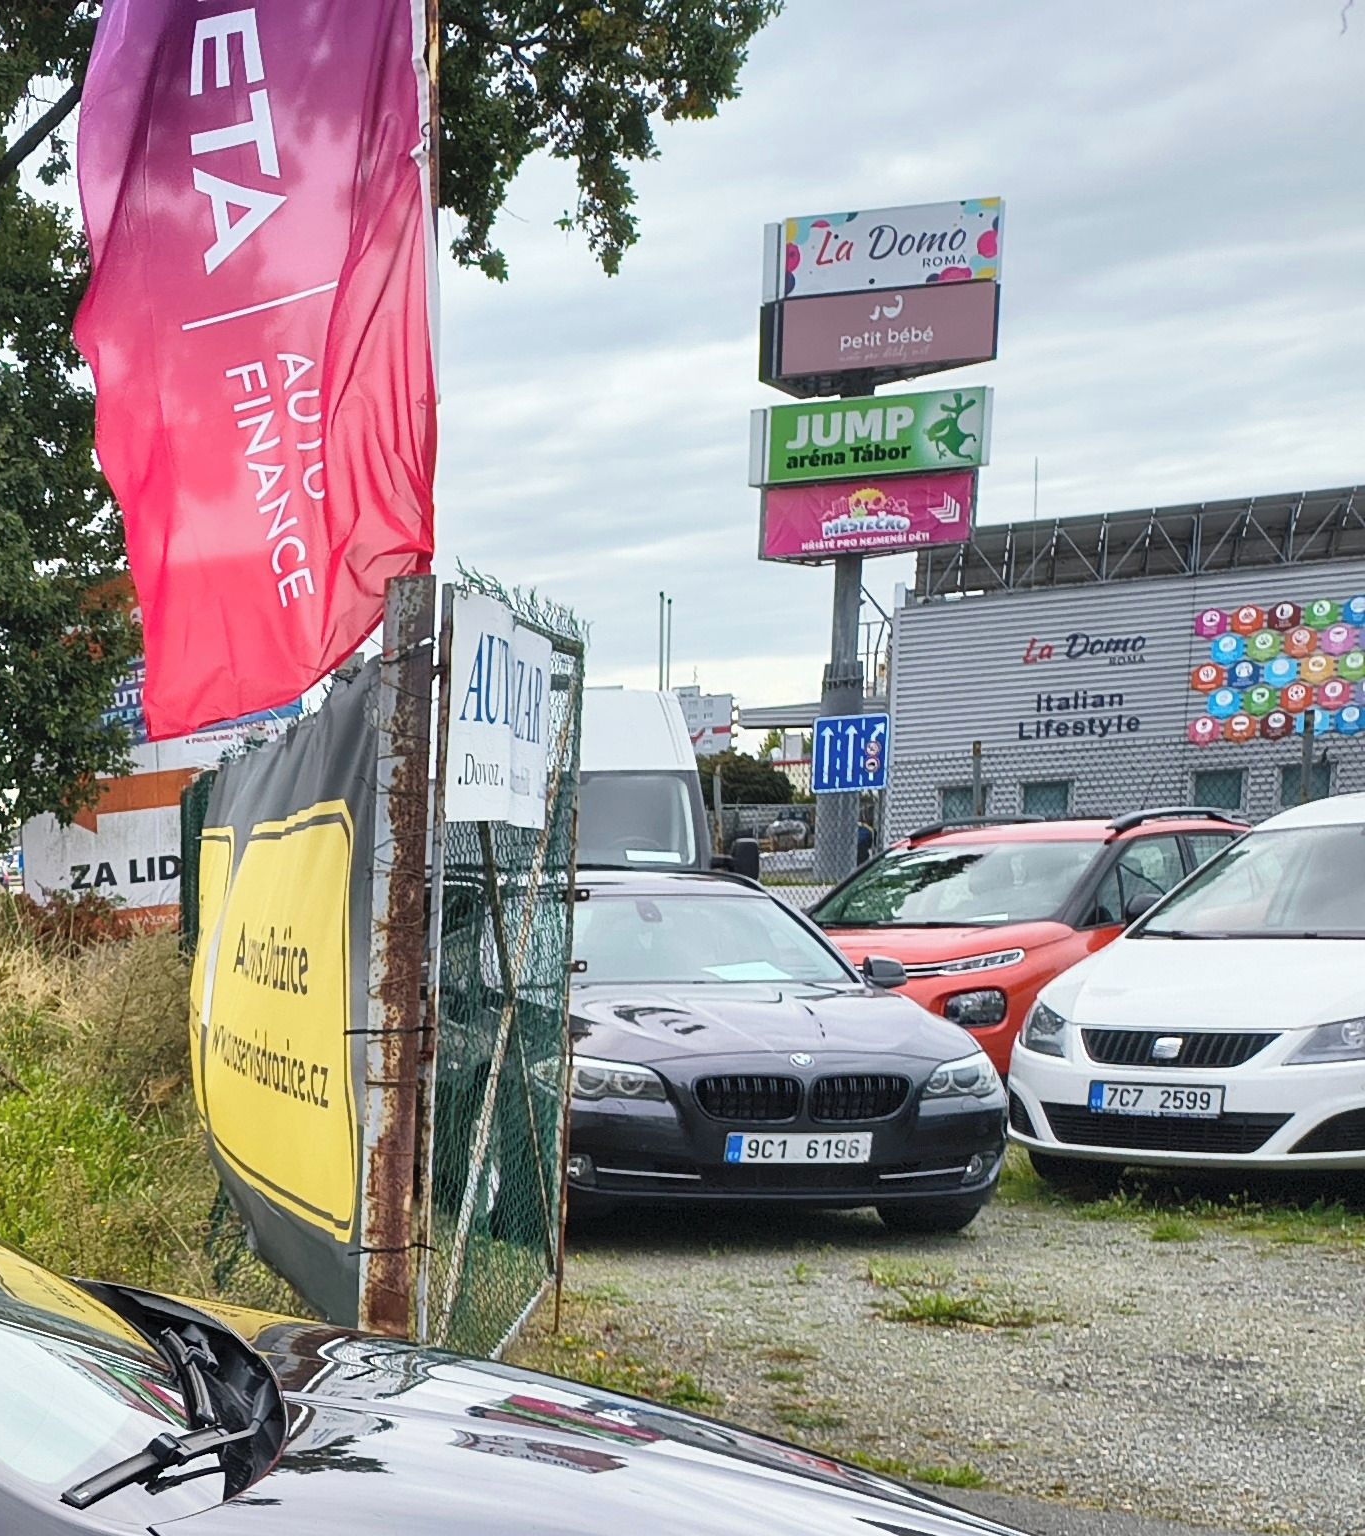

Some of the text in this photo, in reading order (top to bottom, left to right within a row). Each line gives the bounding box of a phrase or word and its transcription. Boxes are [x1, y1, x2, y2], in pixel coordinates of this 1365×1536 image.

[190, 0, 288, 276] ETA
[816, 224, 967, 266] La Domo
[922, 254, 967, 268] ROMA
[840, 325, 934, 351] petit bébé
[785, 406, 915, 450] JUMP
[786, 443, 912, 470] aréna Tábor
[225, 361, 315, 608] FINANCE
[837, 538, 857, 548] PRO
[1023, 633, 1146, 664] La Domo
[1036, 690, 1124, 713] Italian
[1018, 715, 1140, 741] Lifestyle
[70, 863, 117, 890] ZA
[1107, 1087, 1211, 1111] 7C7 2599
[747, 1139, 861, 1159] 9C1 6196
